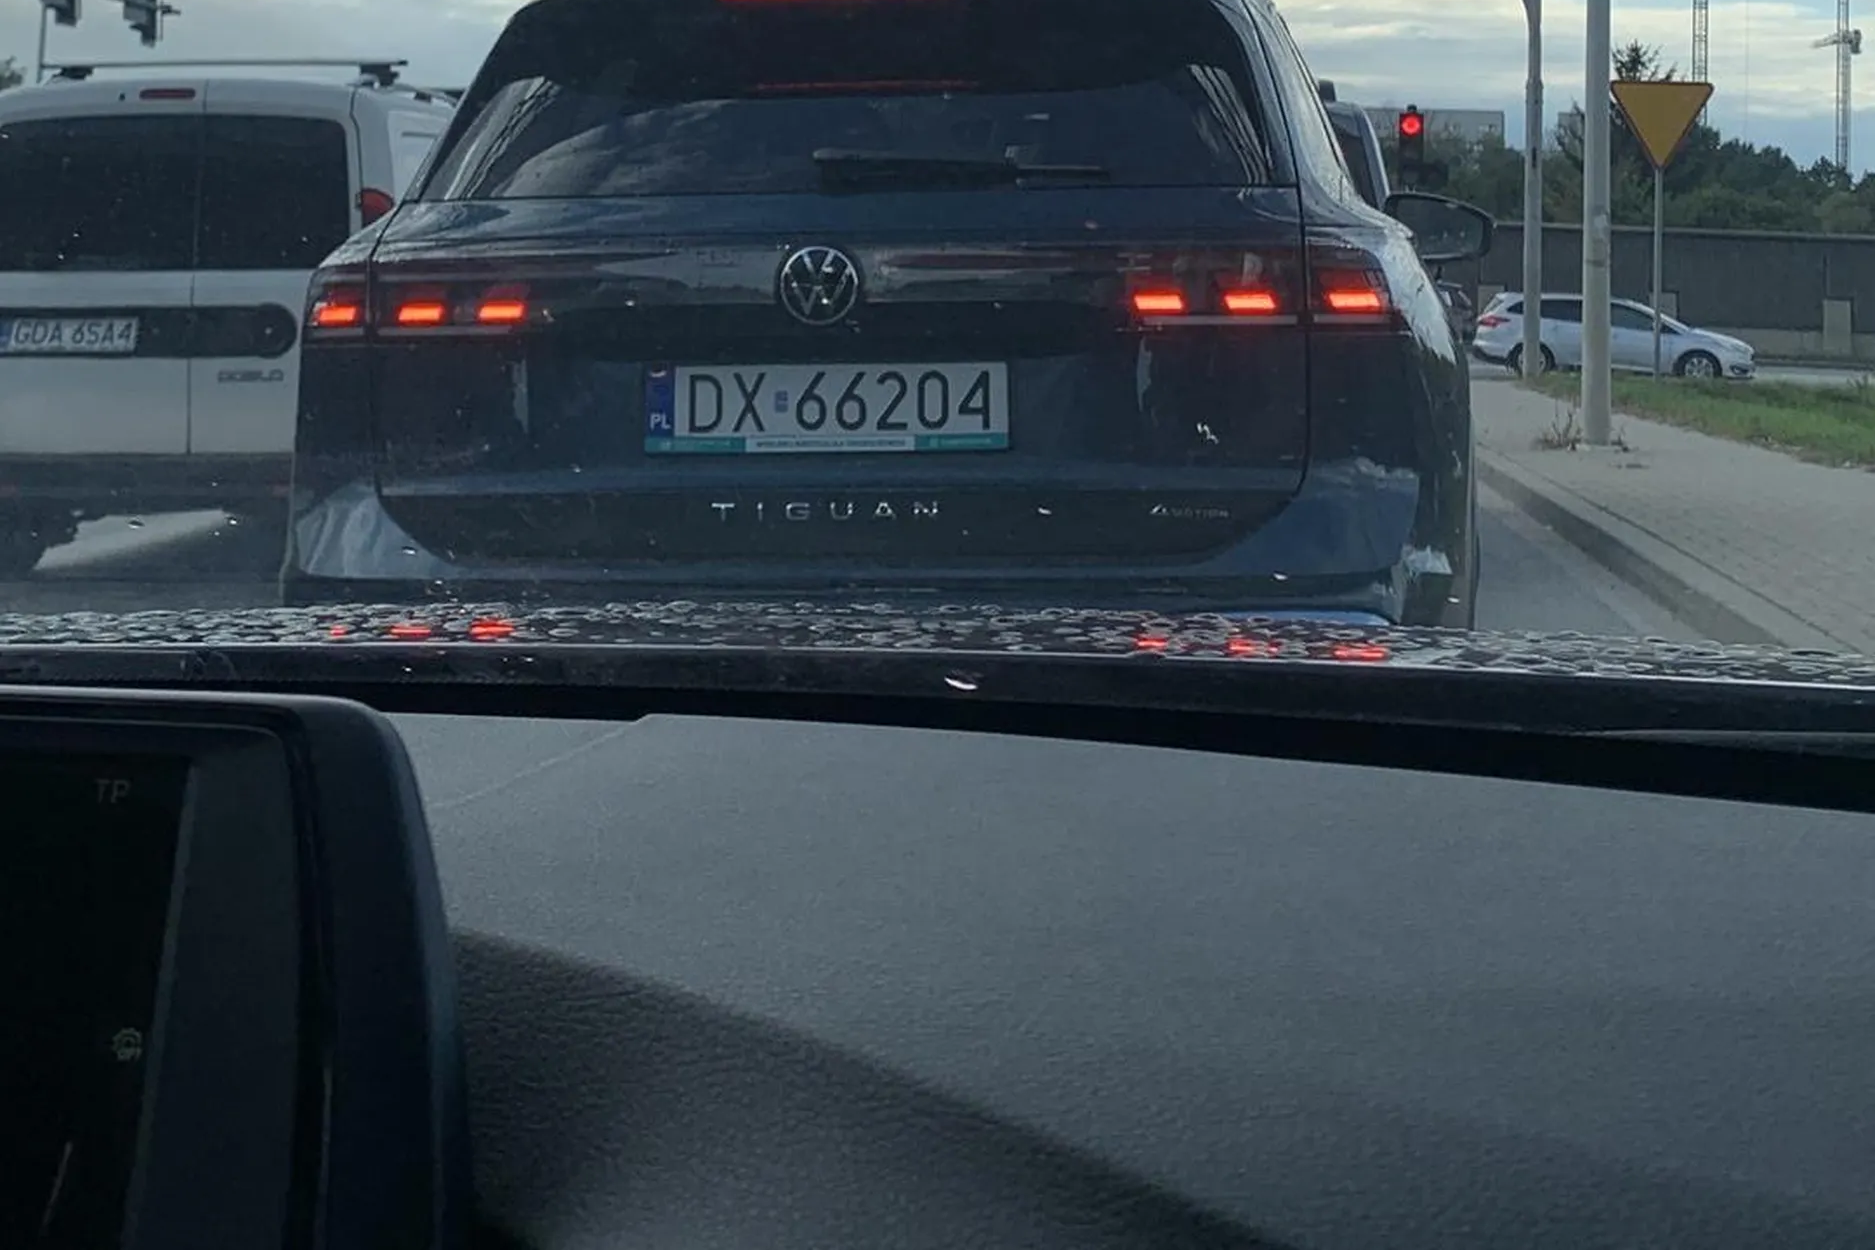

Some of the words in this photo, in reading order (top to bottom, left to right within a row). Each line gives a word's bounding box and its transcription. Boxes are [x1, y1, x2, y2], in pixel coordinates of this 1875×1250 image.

[15, 319, 62, 344] GDA
[72, 320, 132, 345] 6SA4
[689, 372, 766, 433] DX
[795, 370, 991, 432] 66204
[650, 413, 671, 431] PL
[711, 502, 938, 521] TIGUAN
[96, 778, 131, 804] TP
